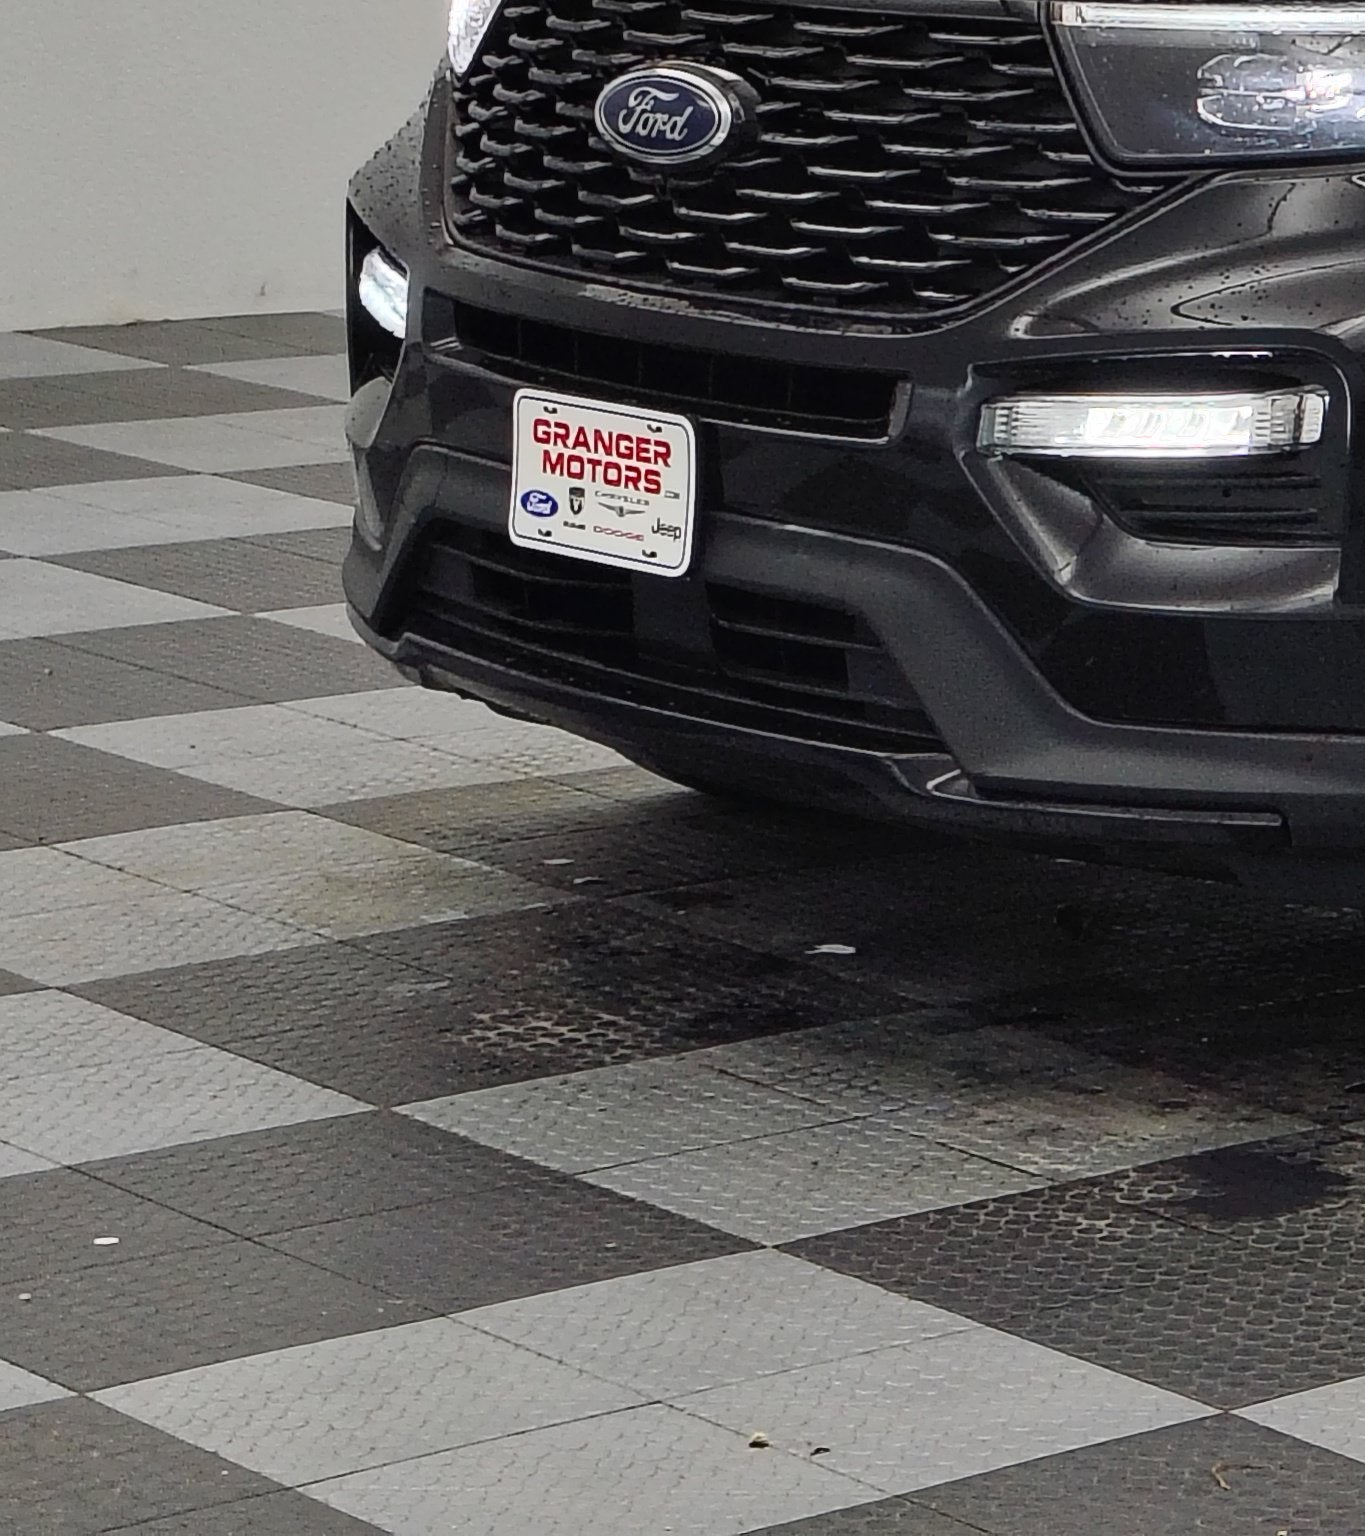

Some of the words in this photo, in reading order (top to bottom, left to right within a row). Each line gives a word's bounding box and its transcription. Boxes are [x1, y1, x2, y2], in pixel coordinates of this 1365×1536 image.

[618, 86, 693, 141] Ford
[532, 418, 672, 468] GRANGER
[542, 449, 662, 495] MOTORS
[651, 517, 682, 542] Jeep
